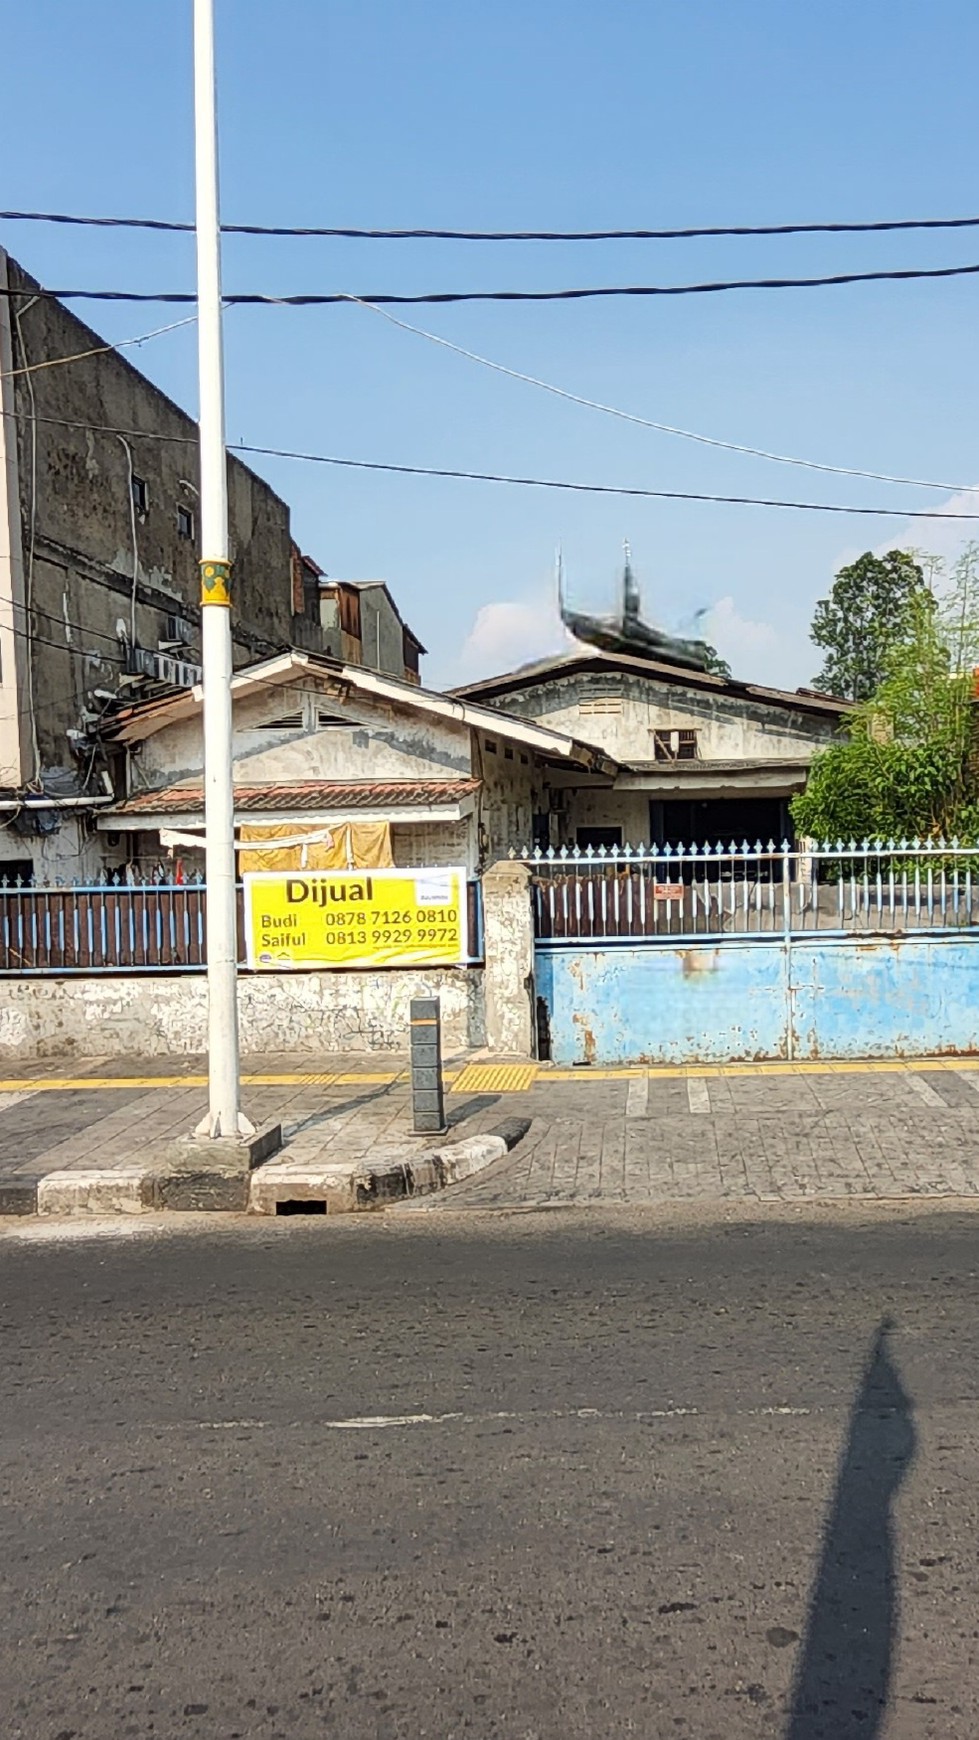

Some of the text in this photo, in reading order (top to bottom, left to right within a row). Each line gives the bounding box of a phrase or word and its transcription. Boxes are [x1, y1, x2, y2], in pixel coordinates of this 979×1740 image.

[286, 876, 373, 907] Dijual
[261, 909, 457, 928] Budi 0878 7126 0810
[261, 928, 458, 947] Saiful 0813 9929 9972
